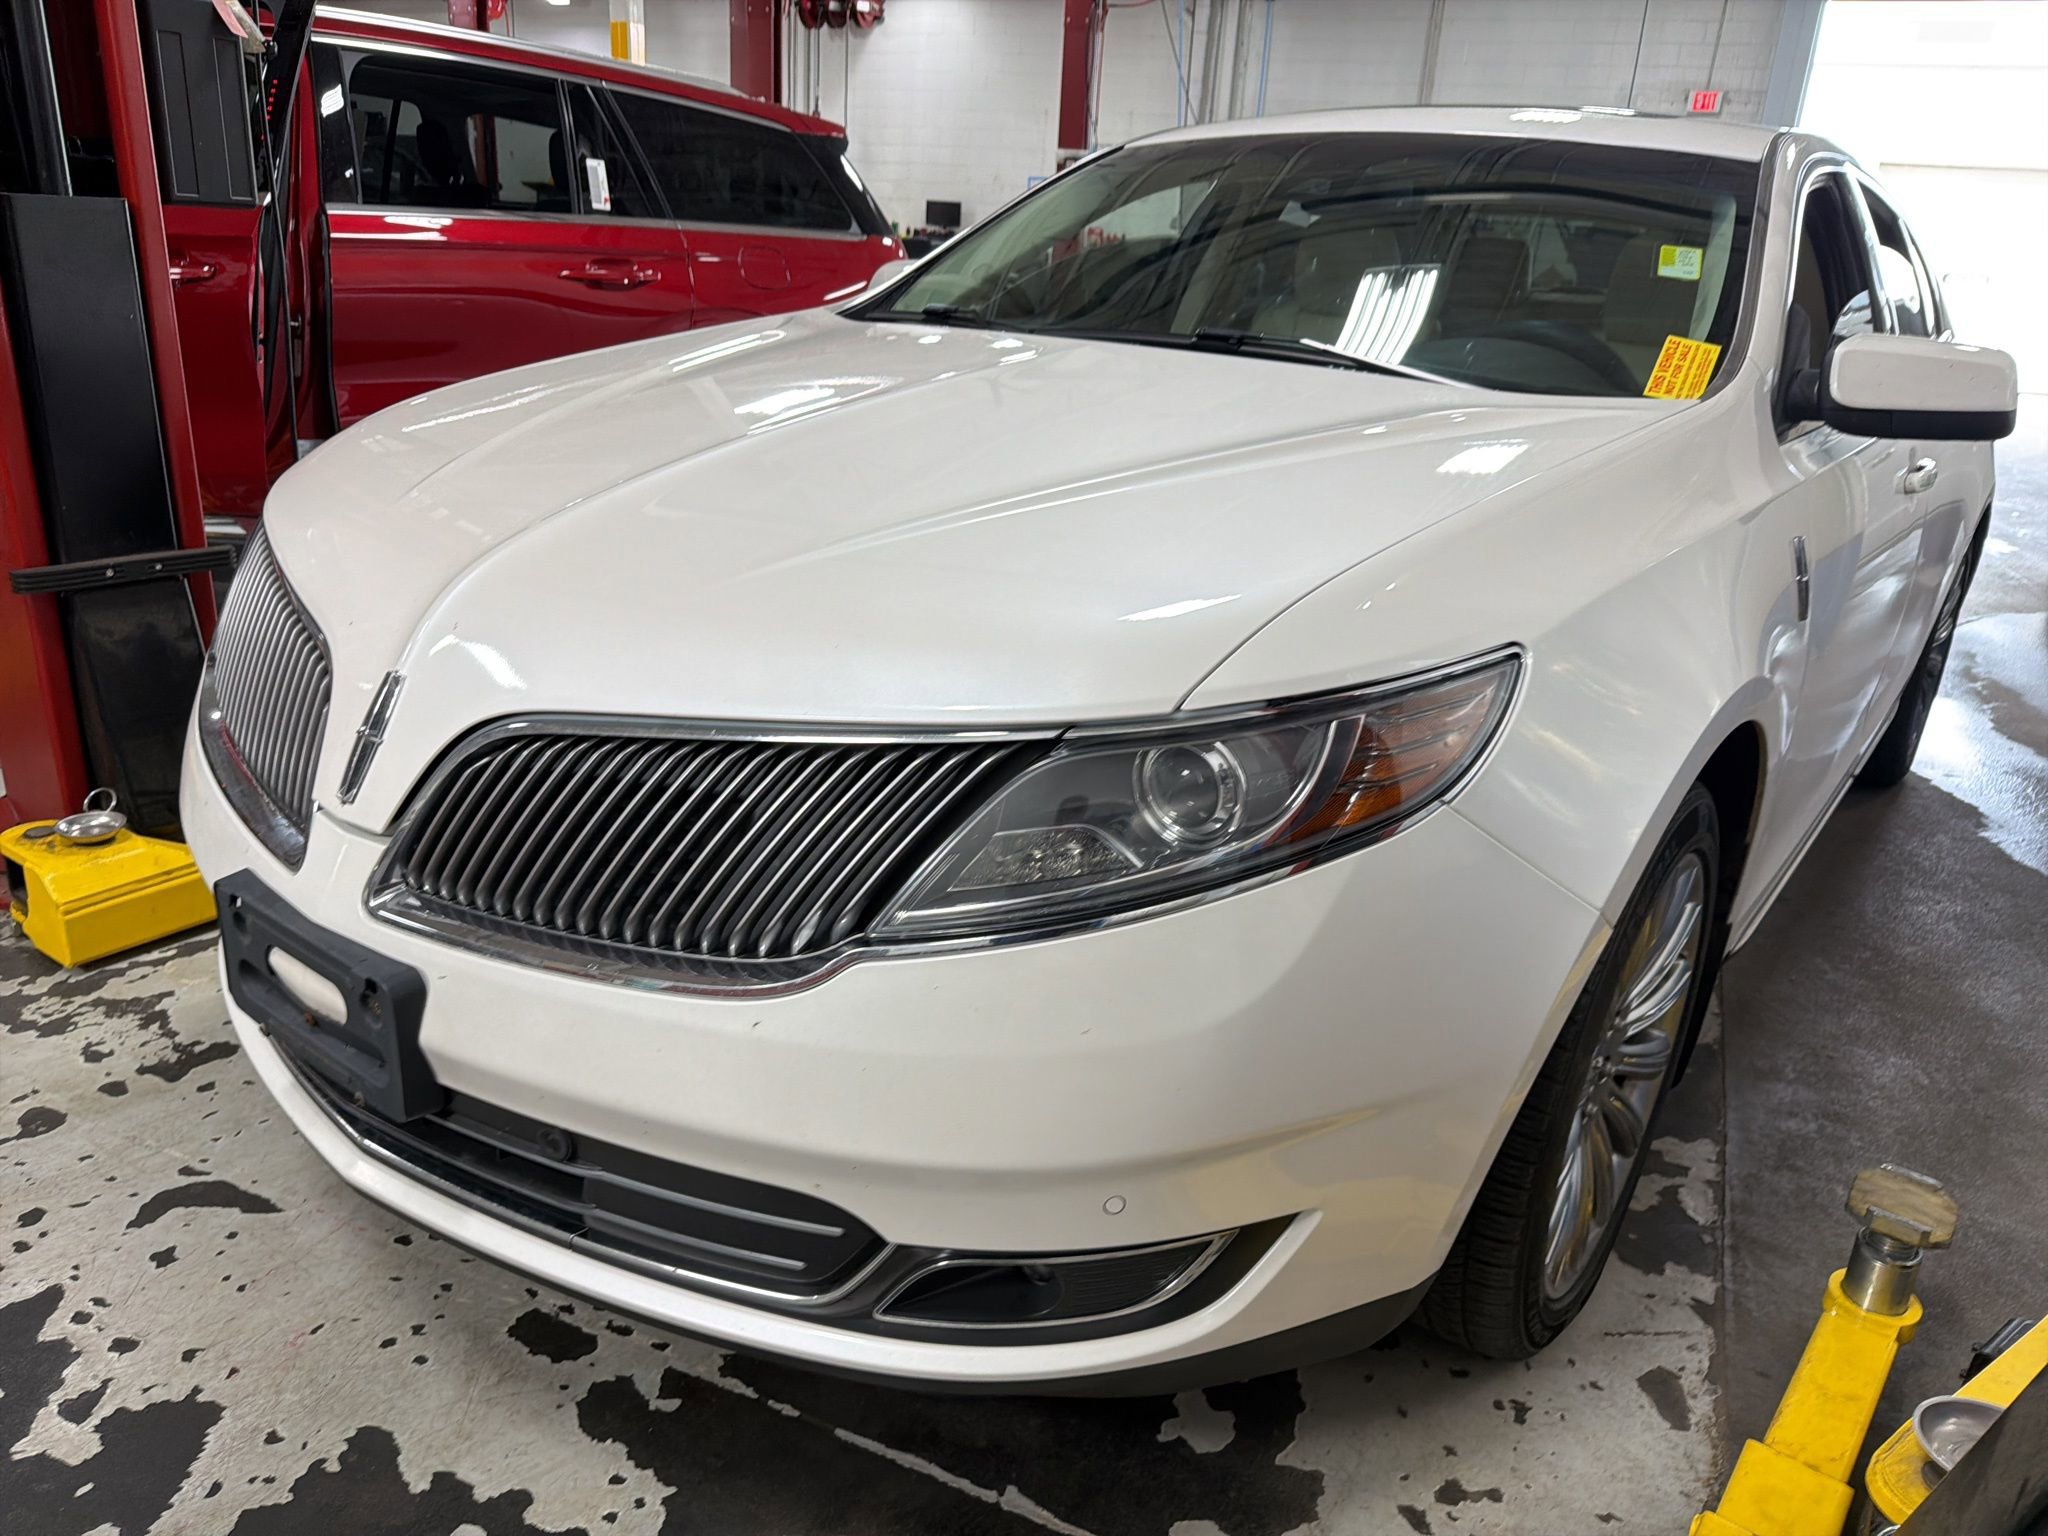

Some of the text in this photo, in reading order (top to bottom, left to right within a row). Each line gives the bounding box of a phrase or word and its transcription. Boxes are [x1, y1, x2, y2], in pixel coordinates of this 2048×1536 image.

[1692, 91, 1718, 112] EXIT
[1677, 343, 1693, 362] SALE
[1648, 339, 1681, 393] THIS VEHICLE
[1671, 364, 1684, 378] FOR
[1664, 379, 1677, 394] NOT
